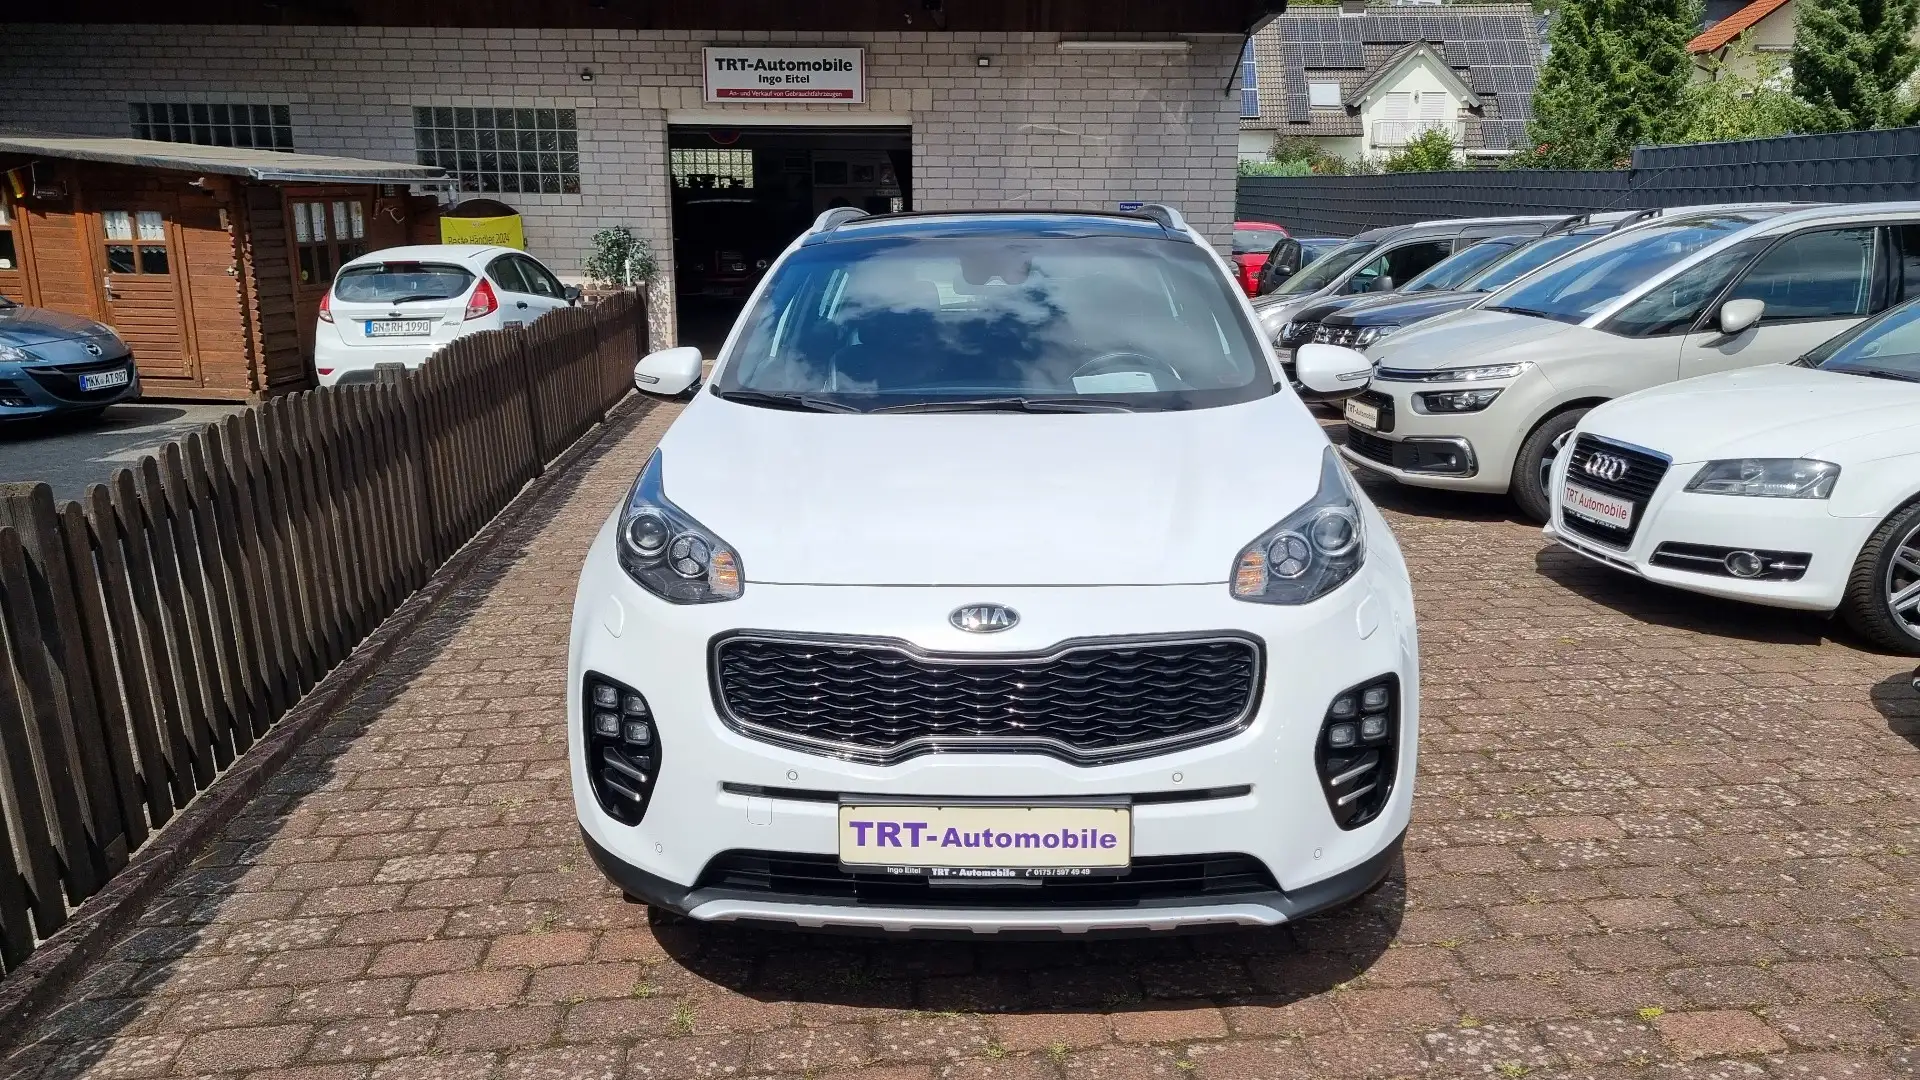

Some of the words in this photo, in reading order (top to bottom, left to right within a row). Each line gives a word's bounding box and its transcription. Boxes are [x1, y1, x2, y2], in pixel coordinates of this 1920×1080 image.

[714, 58, 853, 72] TRT-Automobile
[758, 74, 782, 86] Ingo
[785, 74, 810, 84] Eitel
[784, 90, 843, 98] Gebrauchtfahrzeugen
[495, 232, 511, 245] 2024
[372, 322, 386, 332] GN
[390, 321, 404, 332] RH
[405, 321, 429, 332] 1990
[105, 372, 114, 384] AT
[1566, 487, 1579, 504] TRT
[1578, 493, 1627, 520] Automobile
[961, 607, 1009, 627] KIA
[886, 866, 903, 875] Ingo
[904, 866, 921, 874] Eitel
[931, 868, 950, 877] TRT
[958, 868, 1016, 878] Automobile
[1033, 868, 1051, 876] 0175
[1056, 868, 1070, 876] 597
[1070, 868, 1081, 876] 49
[1081, 868, 1091, 876] 49
